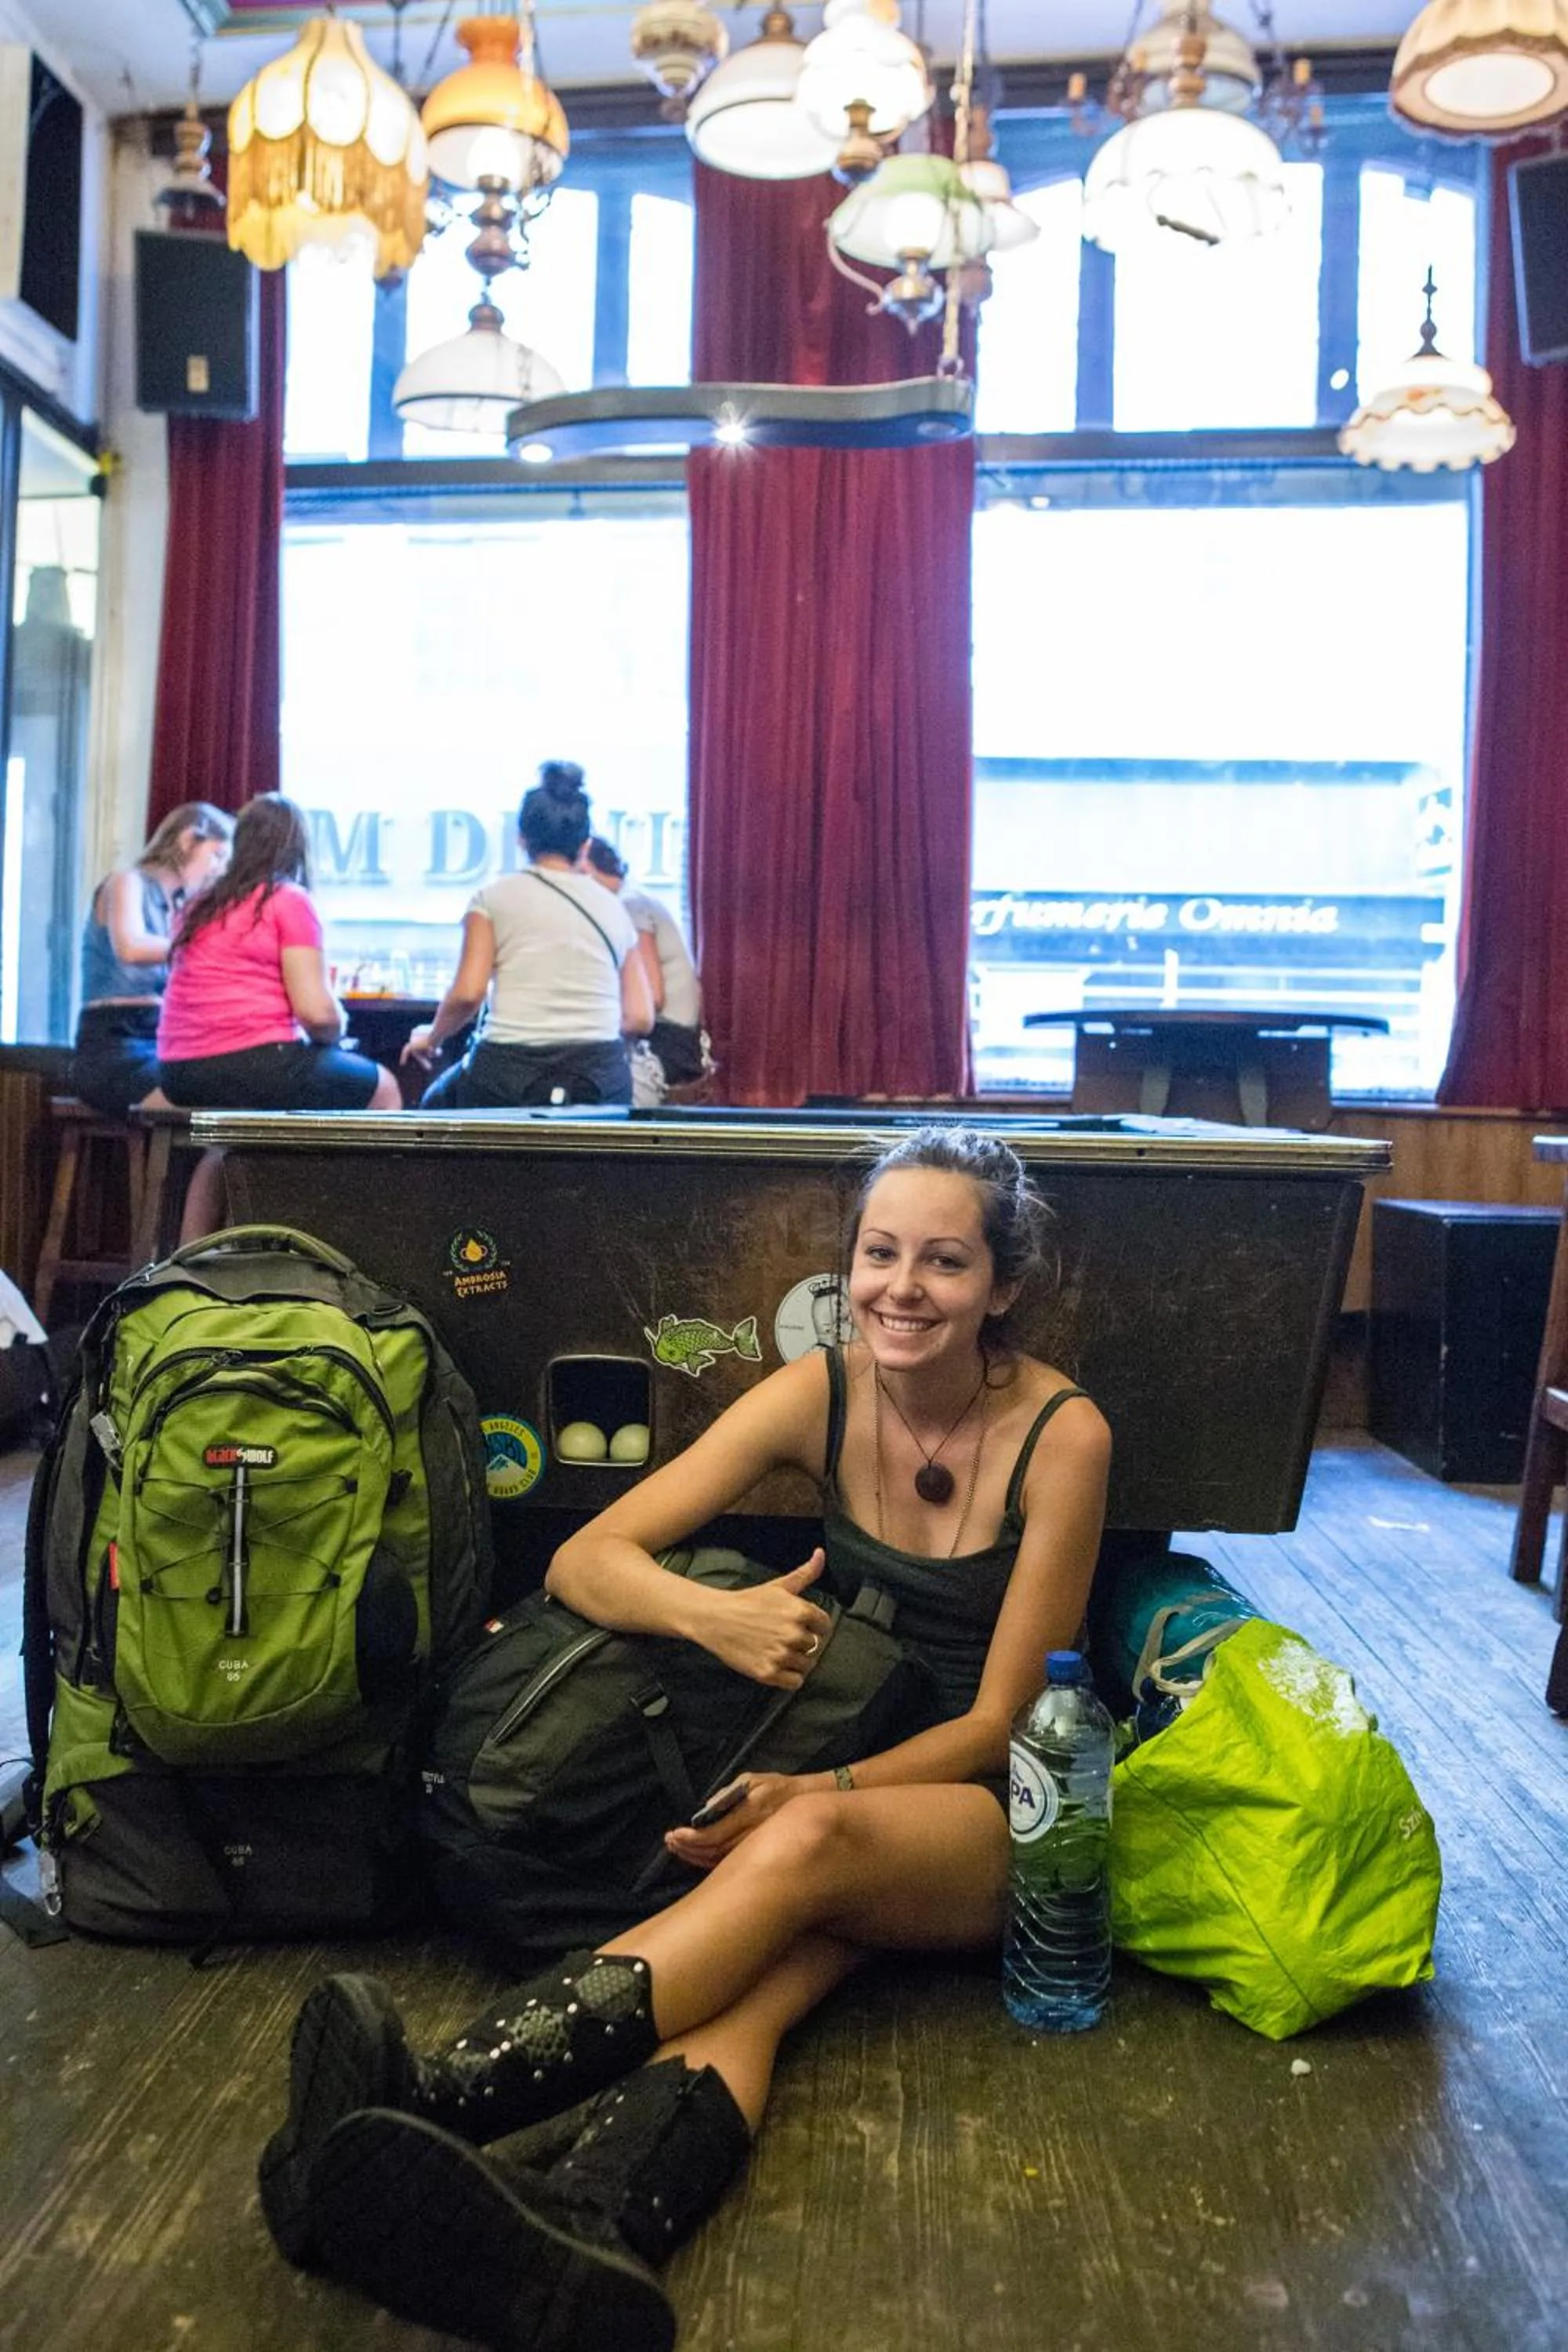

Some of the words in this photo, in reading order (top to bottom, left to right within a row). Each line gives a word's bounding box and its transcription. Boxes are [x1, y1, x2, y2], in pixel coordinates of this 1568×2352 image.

[454, 1270, 506, 1287] AMBROSIA
[456, 1280, 508, 1298] EXTRACTS
[219, 1659, 249, 1670] CUBA
